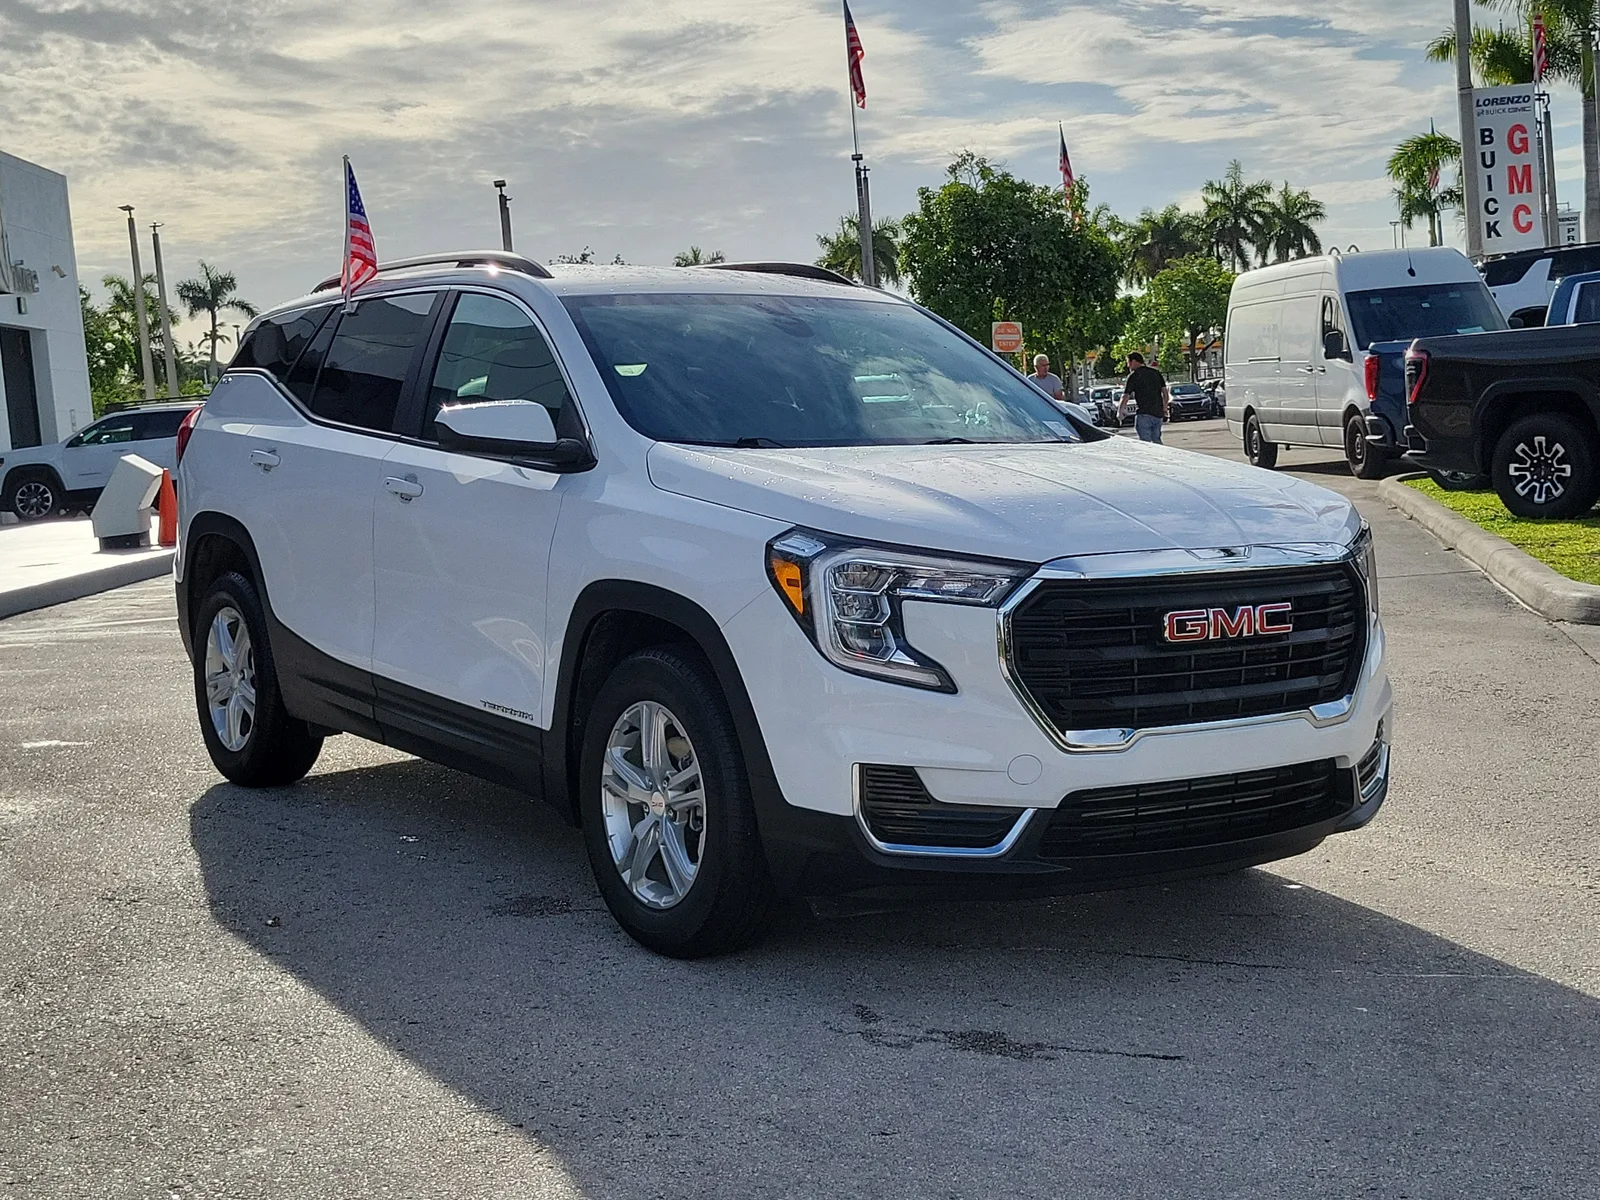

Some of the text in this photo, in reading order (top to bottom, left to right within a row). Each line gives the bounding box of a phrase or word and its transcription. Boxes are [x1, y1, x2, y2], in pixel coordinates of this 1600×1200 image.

[1476, 95, 1531, 107] LORENZO
[1485, 106, 1532, 116] BUICK GMC
[1479, 127, 1502, 239] BUICK
[1506, 123, 1533, 234] GMC
[1163, 602, 1293, 643] GMC
[480, 699, 534, 721] TERRAIN
